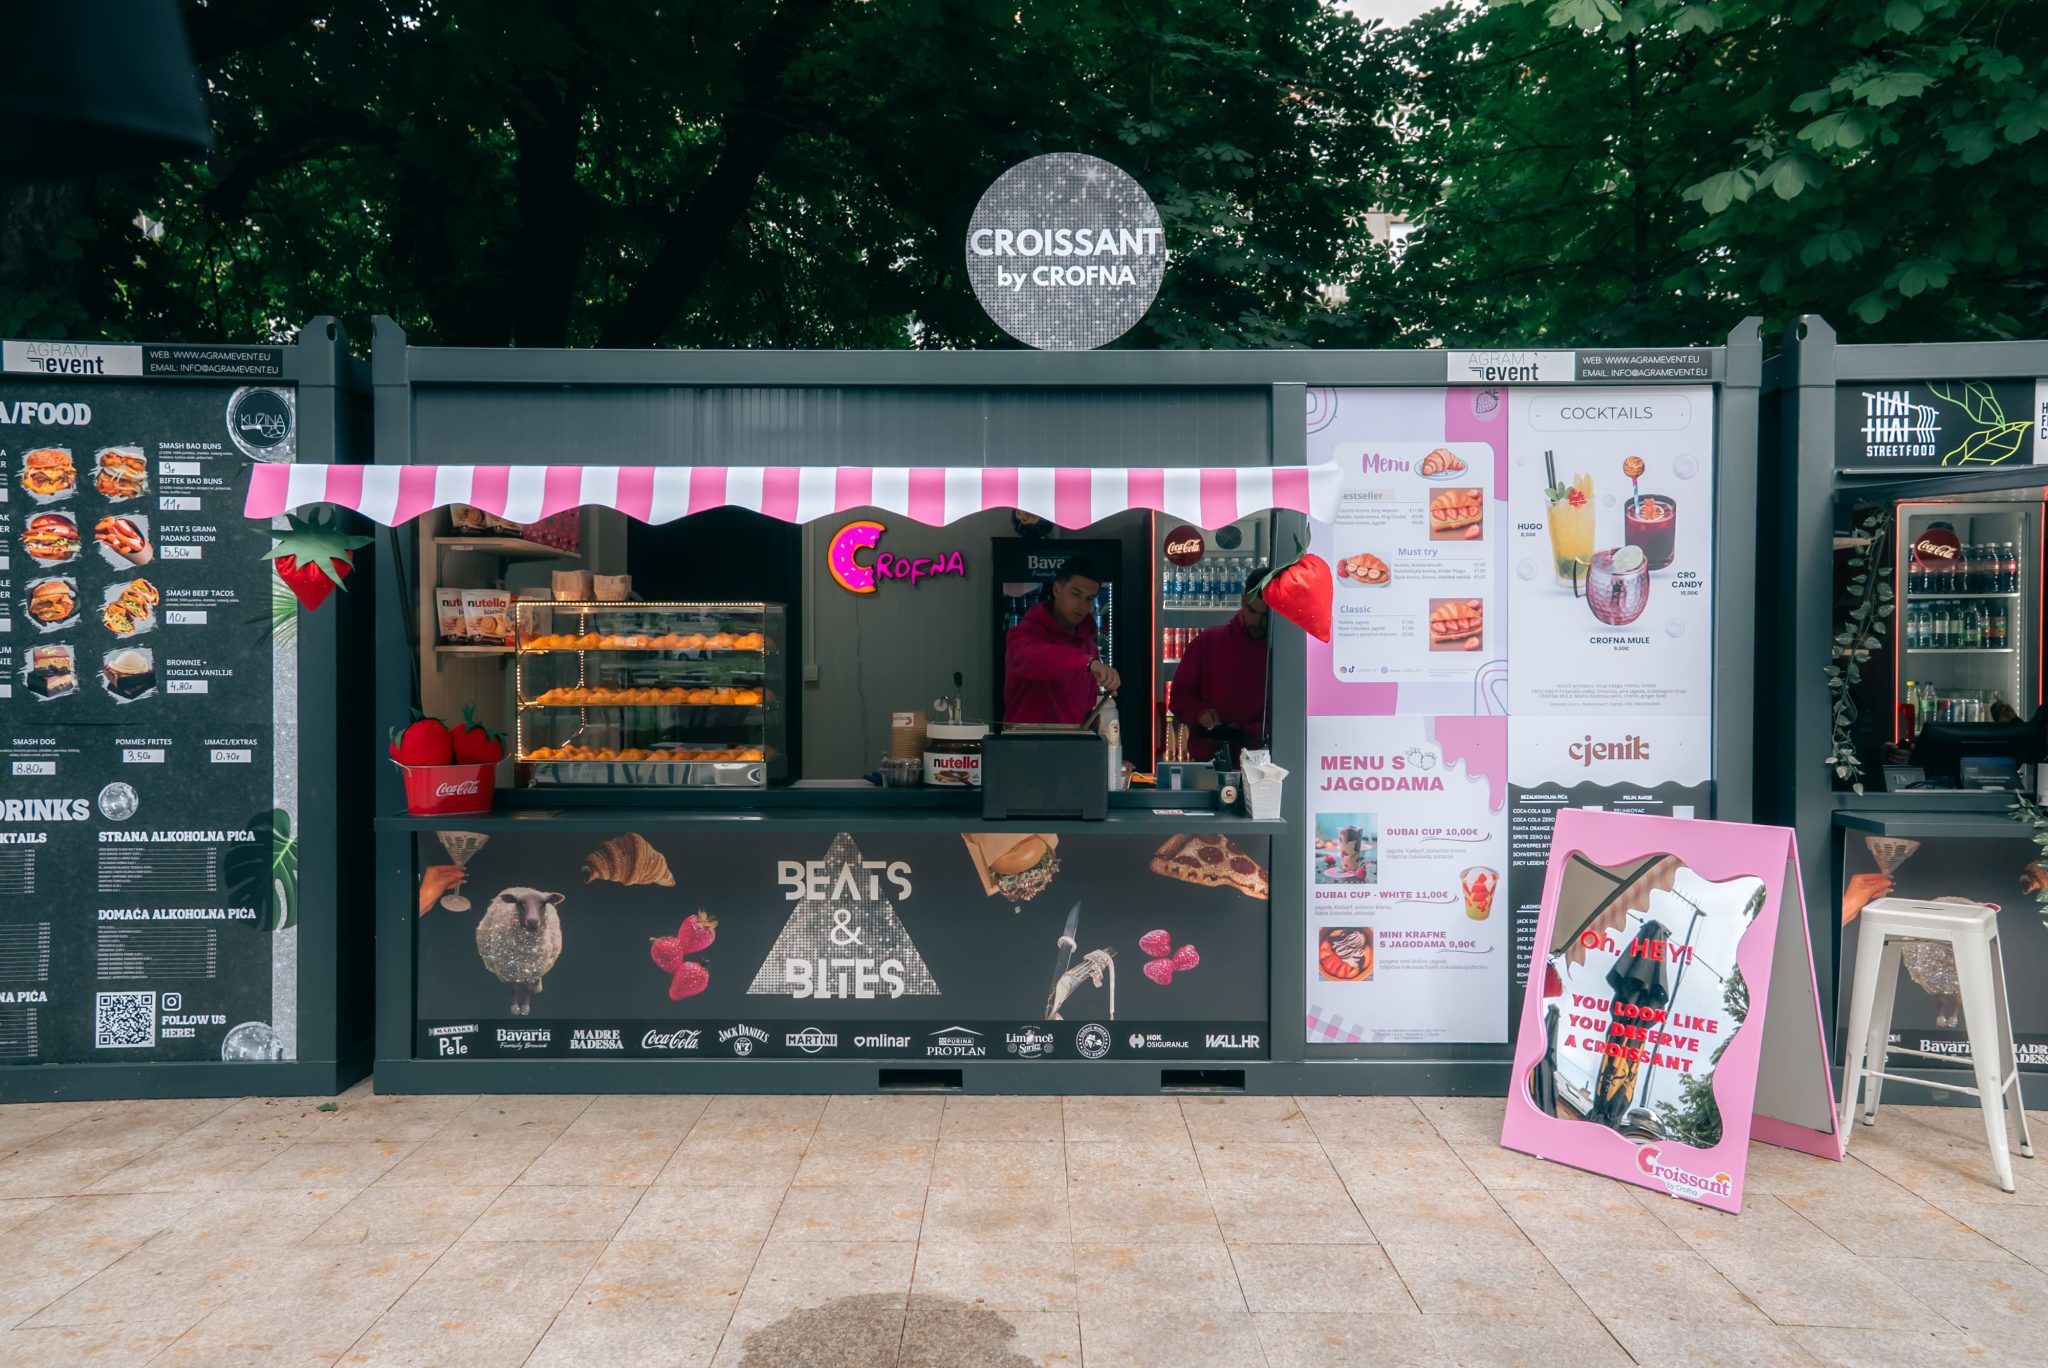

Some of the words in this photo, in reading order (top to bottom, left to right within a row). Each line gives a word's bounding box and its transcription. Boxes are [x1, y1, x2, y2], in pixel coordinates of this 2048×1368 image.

[970, 228, 1161, 256] CROISSANT
[997, 266, 1027, 291] by
[1032, 266, 1136, 286] CROFNA
[26, 343, 88, 357] AGRAM
[150, 351, 170, 360] WEB:
[173, 351, 271, 361] WWW.AGRAMEVENT.EU
[45, 356, 104, 374] event
[1468, 352, 1525, 366] AGRAM
[1605, 355, 1700, 364] WWW.AGRAMEVENT.EU
[150, 364, 178, 372] EMAIL:
[180, 364, 279, 374] INFO@AGRAMEVENT.EU
[1485, 363, 1539, 381] event
[1611, 368, 1708, 377] INFO@AGRAMEVENT.EU
[1861, 391, 1910, 416] THAI
[1560, 406, 1653, 420] COCKTAILS
[1860, 417, 1909, 443] THAI
[1362, 452, 1410, 474] Menu
[1342, 491, 1384, 500] estseller
[1167, 539, 1201, 555] Coca-Cola
[1398, 548, 1422, 556] Must
[1423, 548, 1438, 558] try
[1916, 540, 1956, 560] Coca-Cola
[1677, 571, 1696, 579] CRO
[1671, 581, 1703, 589] CANDY
[467, 598, 506, 608] nutella
[1340, 604, 1372, 614] Classic
[1568, 734, 1650, 767] cjenik
[933, 756, 979, 769] nutella
[1320, 756, 1384, 770] MENU
[1391, 755, 1405, 770] S
[435, 779, 480, 797] Coca-Cola
[1320, 776, 1444, 791] JAGODAMA
[98, 831, 149, 842] STRANA
[150, 831, 226, 842] ALKOHOLNA
[227, 829, 256, 842] PIĆA
[1386, 828, 1419, 836] DUBAI
[1421, 828, 1442, 836] CUP
[1445, 828, 1479, 837] 10,00€
[777, 860, 912, 901] BEATS
[1315, 891, 1347, 899] DUBAI
[1350, 891, 1371, 899] CUP
[1380, 891, 1413, 899] WHITE
[1415, 891, 1448, 900] 11,00€
[98, 908, 150, 920] DOMAĆA
[152, 909, 226, 920] ALKOHOLNA
[228, 907, 256, 920] PIĆA
[830, 908, 863, 945] &
[1379, 931, 1402, 939] MINI
[1405, 931, 1447, 939] KRAFNE
[1379, 940, 1386, 948] S
[1388, 940, 1446, 948] JAGODAMA
[1448, 940, 1476, 949] 9,90€
[1580, 929, 1621, 957] Oh,
[1630, 937, 1694, 966] HEY!
[785, 958, 905, 999] BITES
[17, 990, 48, 1002] PIĆA
[162, 1015, 210, 1025] FOLLOW
[211, 1015, 226, 1024] US
[1571, 993, 1610, 1012] YOU
[1613, 1001, 1668, 1025] LOOK
[1673, 1013, 1719, 1034] LIKE
[162, 1028, 196, 1038] HERE!
[496, 1028, 551, 1042] Bavaria
[573, 1029, 620, 1040] MADRE
[641, 1029, 702, 1050] Coca-Cola
[718, 1026, 739, 1043] JACK
[1568, 1013, 1607, 1033] YOU
[1611, 1021, 1700, 1052] DESERVE
[569, 1039, 624, 1050] BADESSA
[788, 1034, 837, 1046] MARTINI
[866, 1034, 911, 1047] mlinar
[1205, 1034, 1260, 1048] WALL.HR
[1919, 1039, 1971, 1054] Bavari
[927, 1046, 952, 1056] PRO
[954, 1046, 986, 1056] PLAN
[1564, 1034, 1578, 1048] A
[1582, 1038, 1693, 1073] CROISSANT
[1637, 1147, 1731, 1196] Croissant
[1666, 1182, 1675, 1190] by
[1675, 1184, 1698, 1196] Crofna
